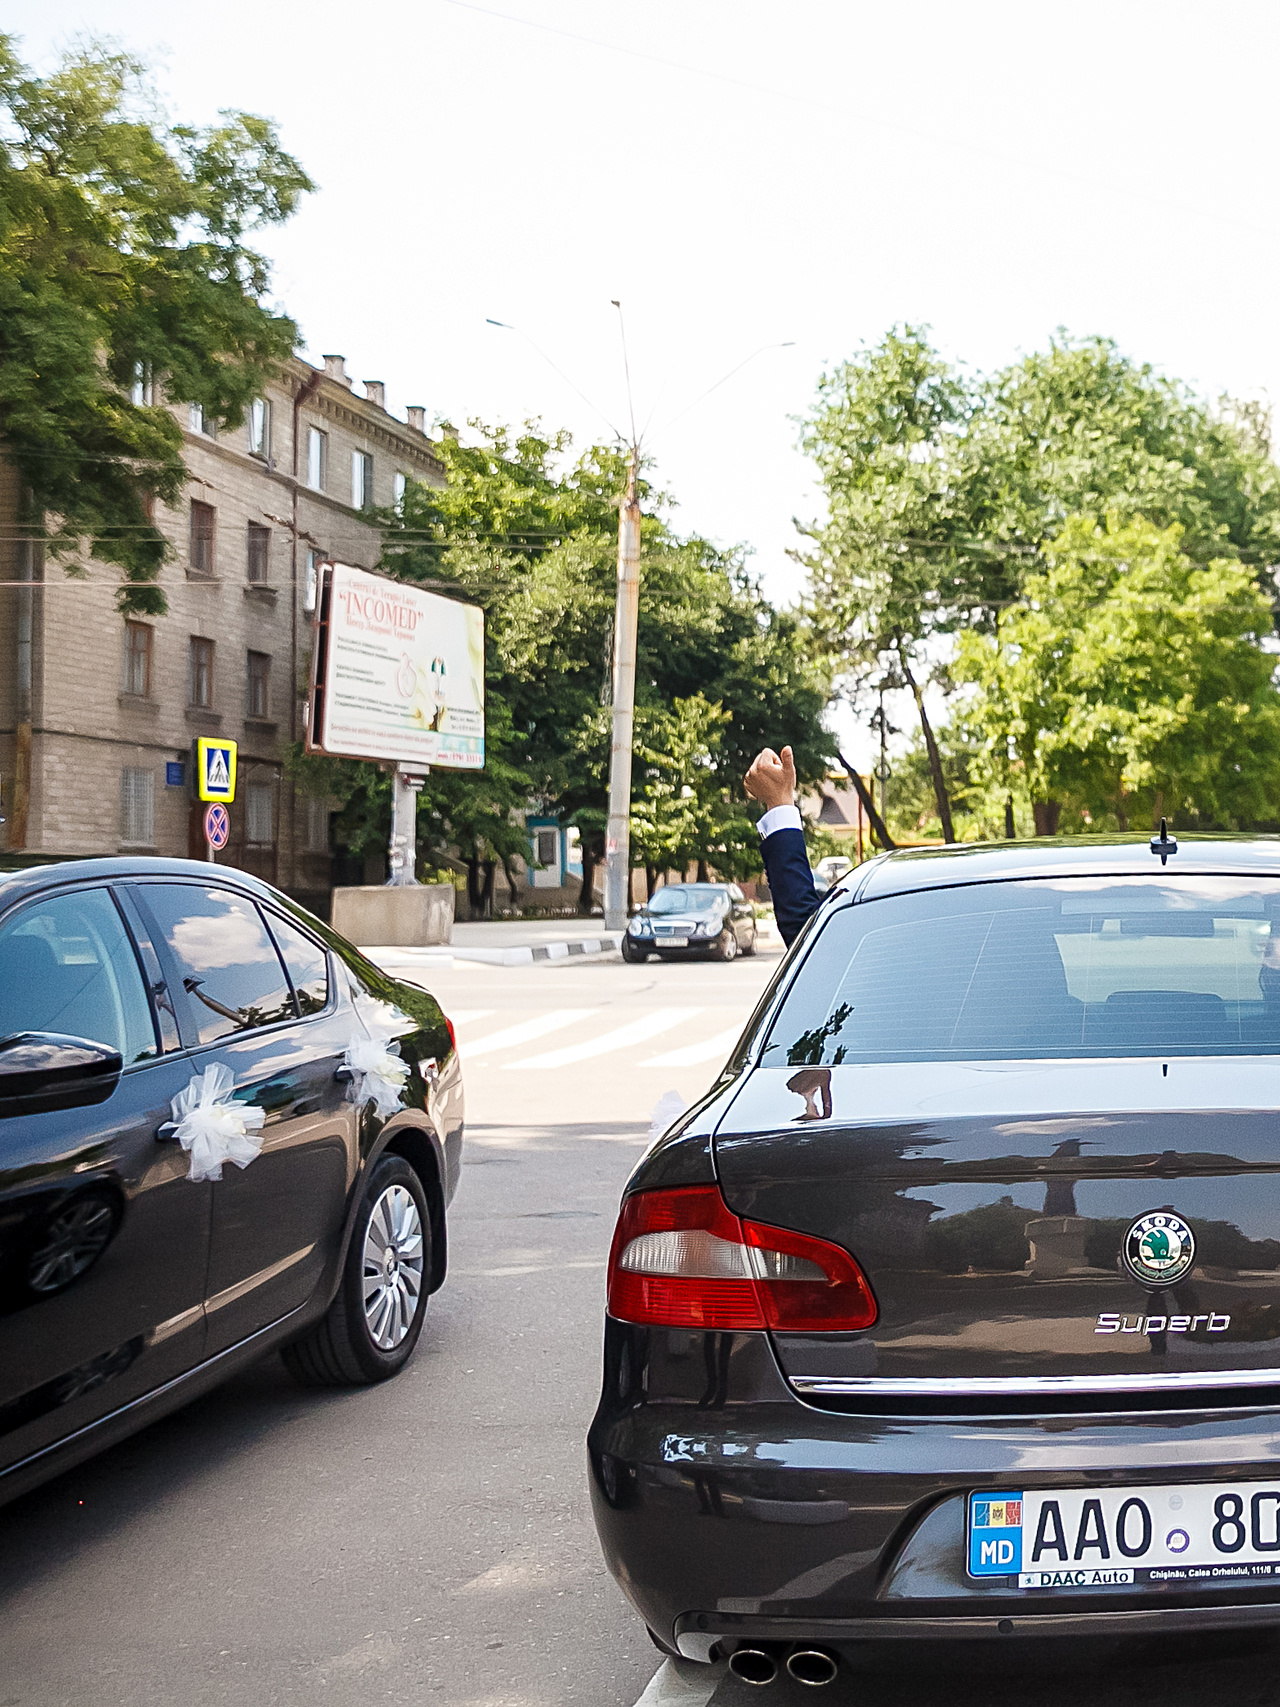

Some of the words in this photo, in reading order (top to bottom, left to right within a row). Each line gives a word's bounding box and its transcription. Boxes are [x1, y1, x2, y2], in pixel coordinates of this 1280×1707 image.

[1094, 1312, 1231, 1335] Superb
[980, 1539, 1014, 1565] MD
[1040, 1571, 1086, 1587] DAAC
[1092, 1570, 1129, 1584] Auto
